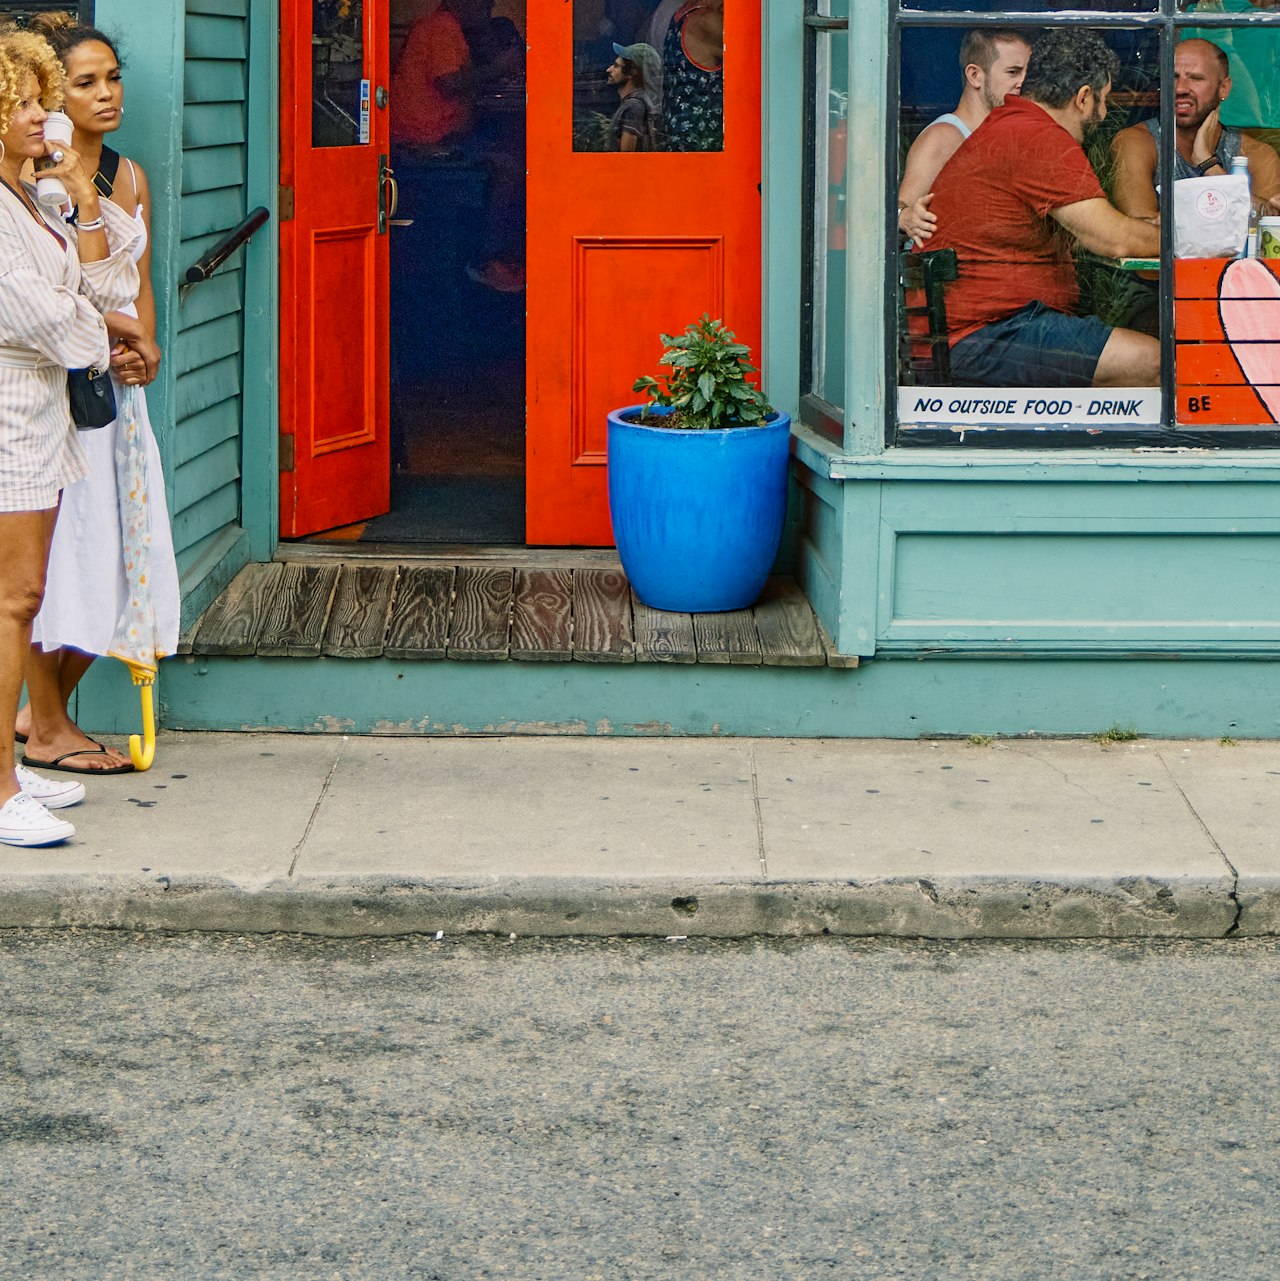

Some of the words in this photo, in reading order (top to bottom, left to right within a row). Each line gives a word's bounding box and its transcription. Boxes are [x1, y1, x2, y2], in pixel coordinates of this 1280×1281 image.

[914, 398, 943, 413] NO
[948, 399, 1018, 414] OUTSIDE
[1023, 399, 1073, 415] FOOD
[1086, 399, 1144, 417] DRINK
[1187, 395, 1212, 413] BE
